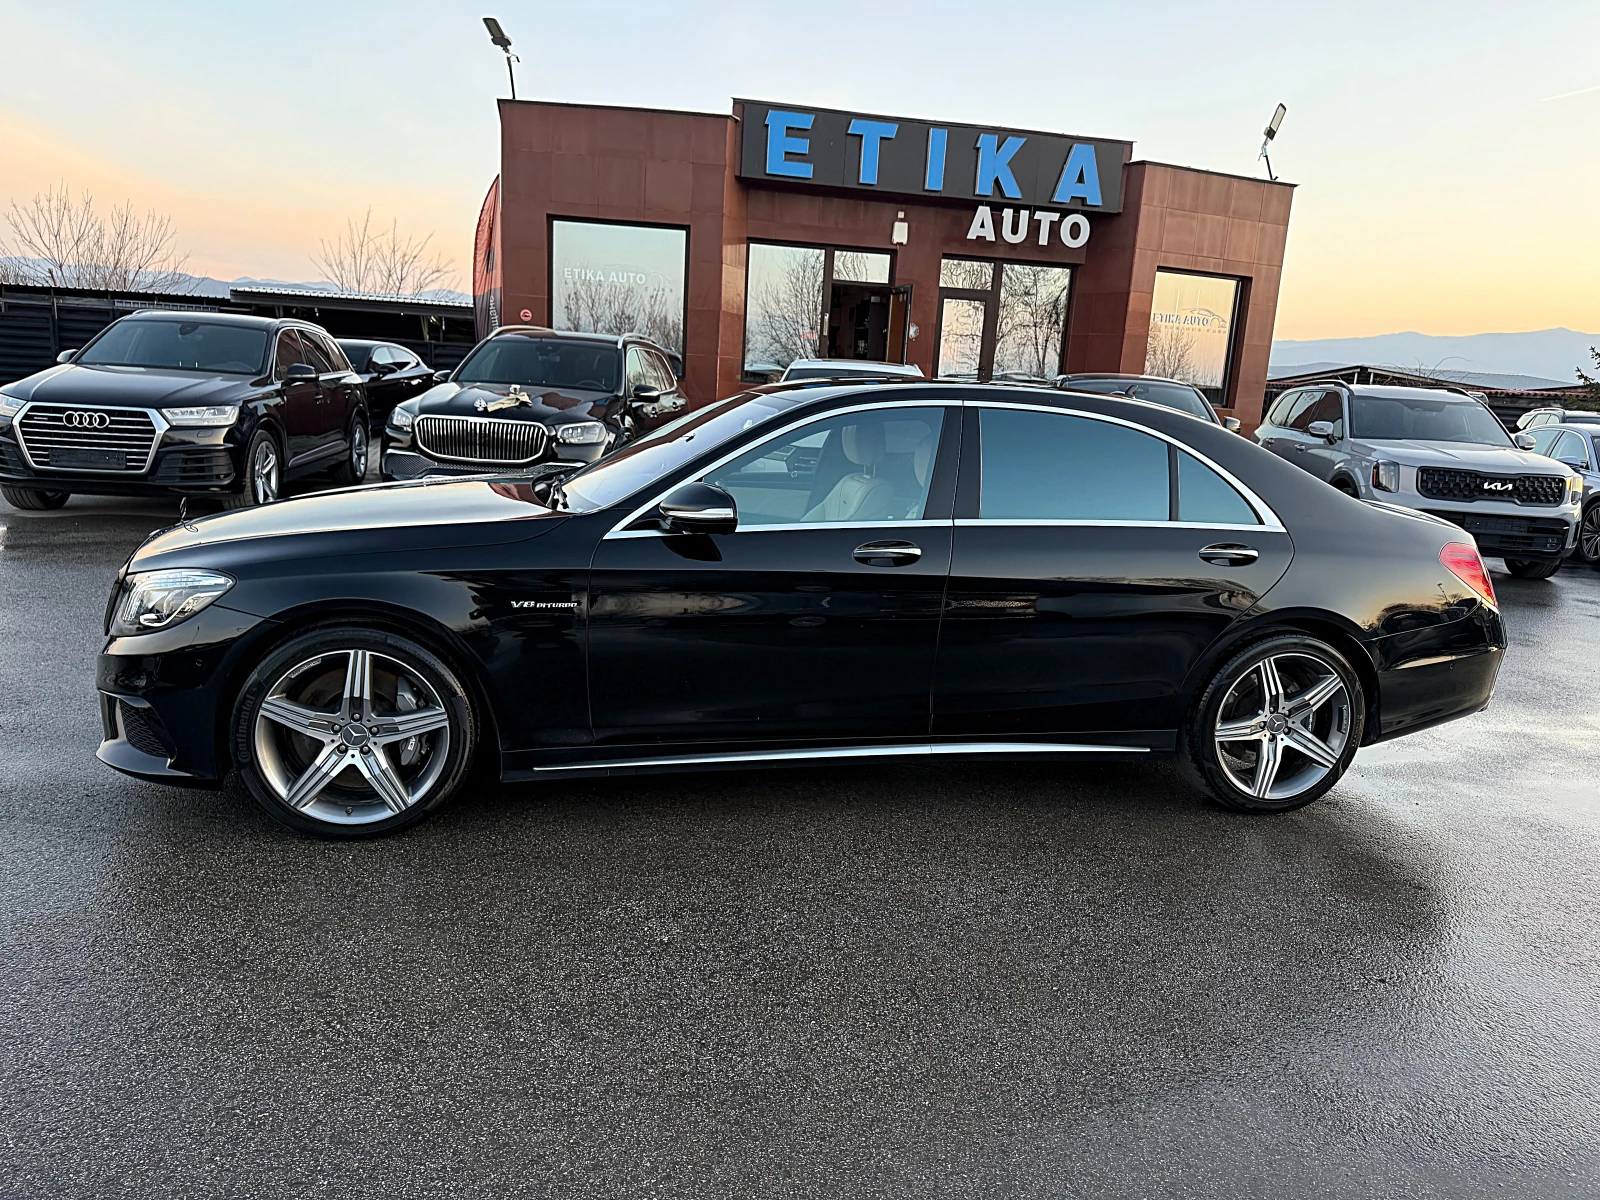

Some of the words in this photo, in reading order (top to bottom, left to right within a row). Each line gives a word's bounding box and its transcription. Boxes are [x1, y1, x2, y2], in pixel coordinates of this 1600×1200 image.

[765, 109, 1103, 206] ETIKA
[966, 205, 1091, 249] AUTO
[563, 267, 605, 282] ETIKA
[609, 271, 646, 285] AUTO
[1153, 313, 1182, 325] ETIKA
[1183, 316, 1210, 326] AUTO
[1483, 481, 1513, 490] KIA
[510, 600, 536, 609] V8
[236, 694, 257, 763] Continental
